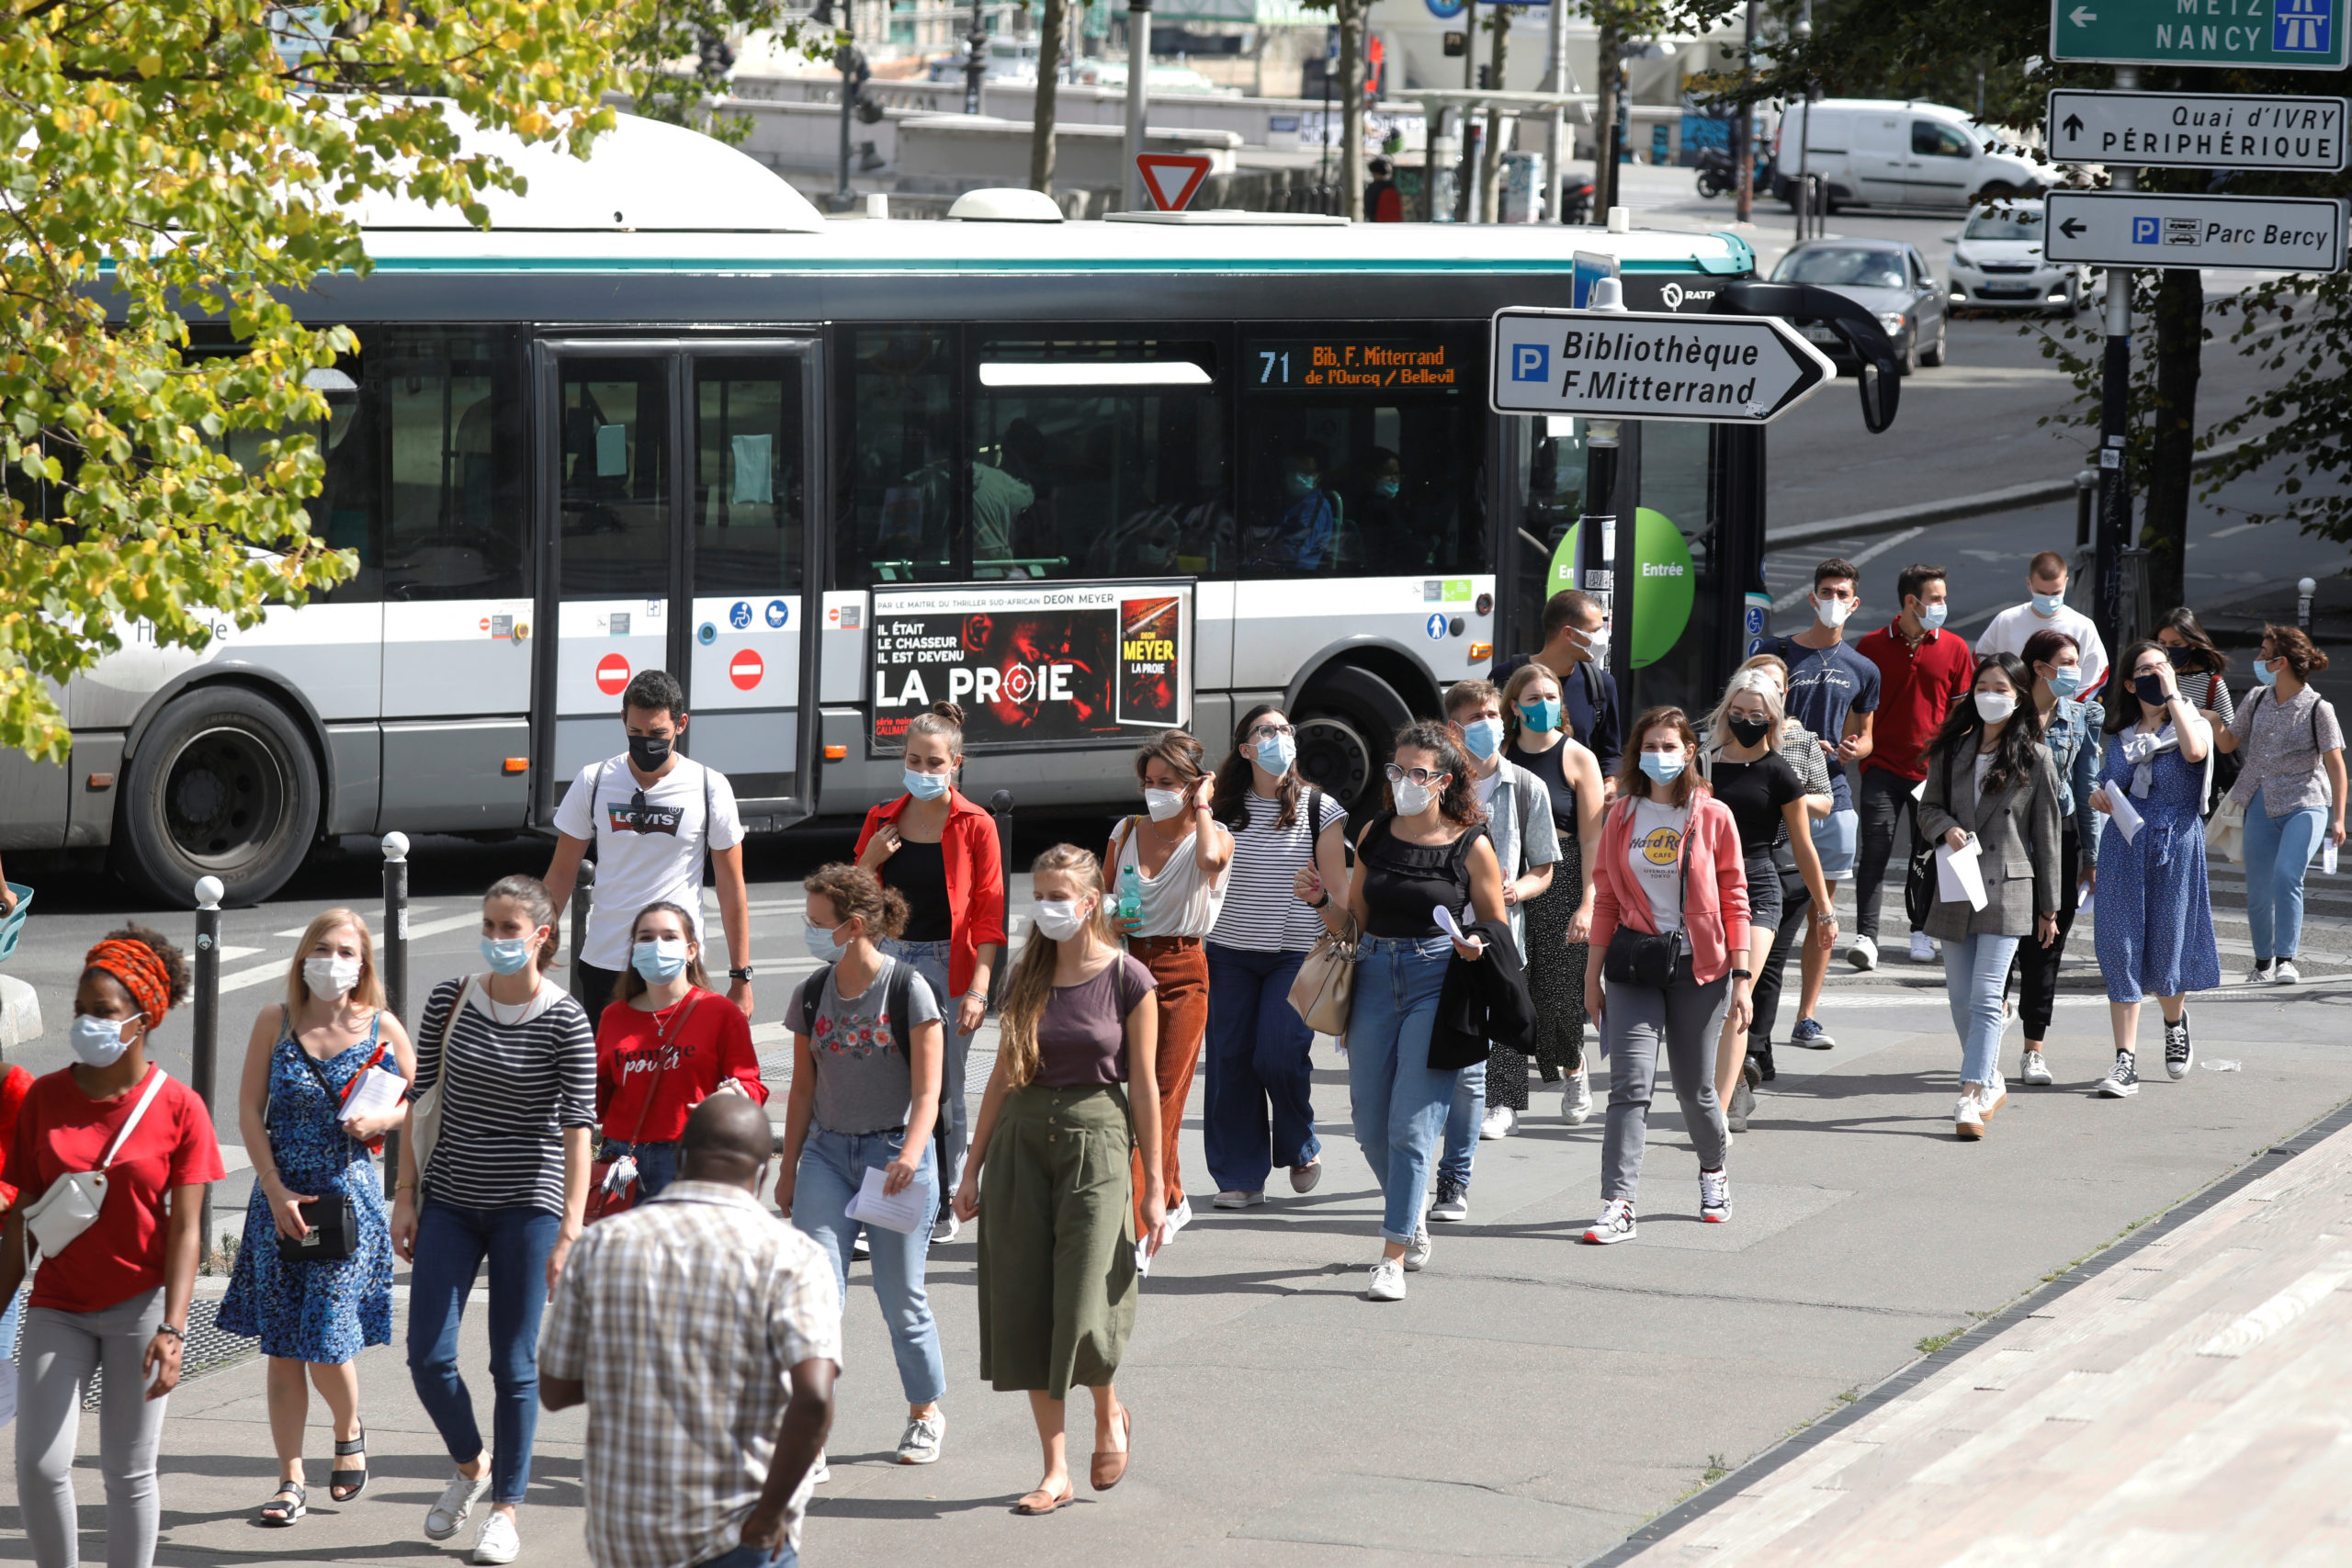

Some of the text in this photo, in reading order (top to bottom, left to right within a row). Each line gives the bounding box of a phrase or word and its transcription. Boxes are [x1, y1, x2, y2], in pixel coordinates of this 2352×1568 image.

[2156, 24, 2262, 51] NANCY
[2172, 106, 2335, 130] Quai d'IVRY
[2103, 128, 2331, 158] PÉRIPHÉRIQUE
[2137, 220, 2327, 251] P Parc Bercy
[1685, 290, 1715, 299] RATP
[1312, 345, 1444, 367] Bib. F. Mitterrand
[1562, 331, 1758, 371] Bibliothèque
[1260, 351, 1289, 383] 71
[1519, 348, 1543, 378] P
[1305, 369, 1323, 384] de
[1329, 369, 1381, 387] l'Ourcq
[1400, 368, 1454, 384] Bellevil
[1561, 369, 1757, 404] F.Mitterrand
[1642, 561, 1684, 577] Entrée
[989, 598, 1040, 606] SUD-AFRICAIN
[1044, 594, 1074, 604] DEON
[1079, 593, 1114, 604] MEYER
[877, 621, 924, 636] IL ÉTAIT
[1140, 631, 1156, 639] DEON
[877, 636, 957, 650] LE CHASSEUR
[1124, 639, 1175, 660] MEYER
[877, 649, 965, 664] IL EST DEVENU
[1131, 663, 1165, 674] LA PROIE
[876, 662, 1074, 707] LA PROIE
[876, 716, 893, 726] série
[1630, 835, 1665, 849] Hard
